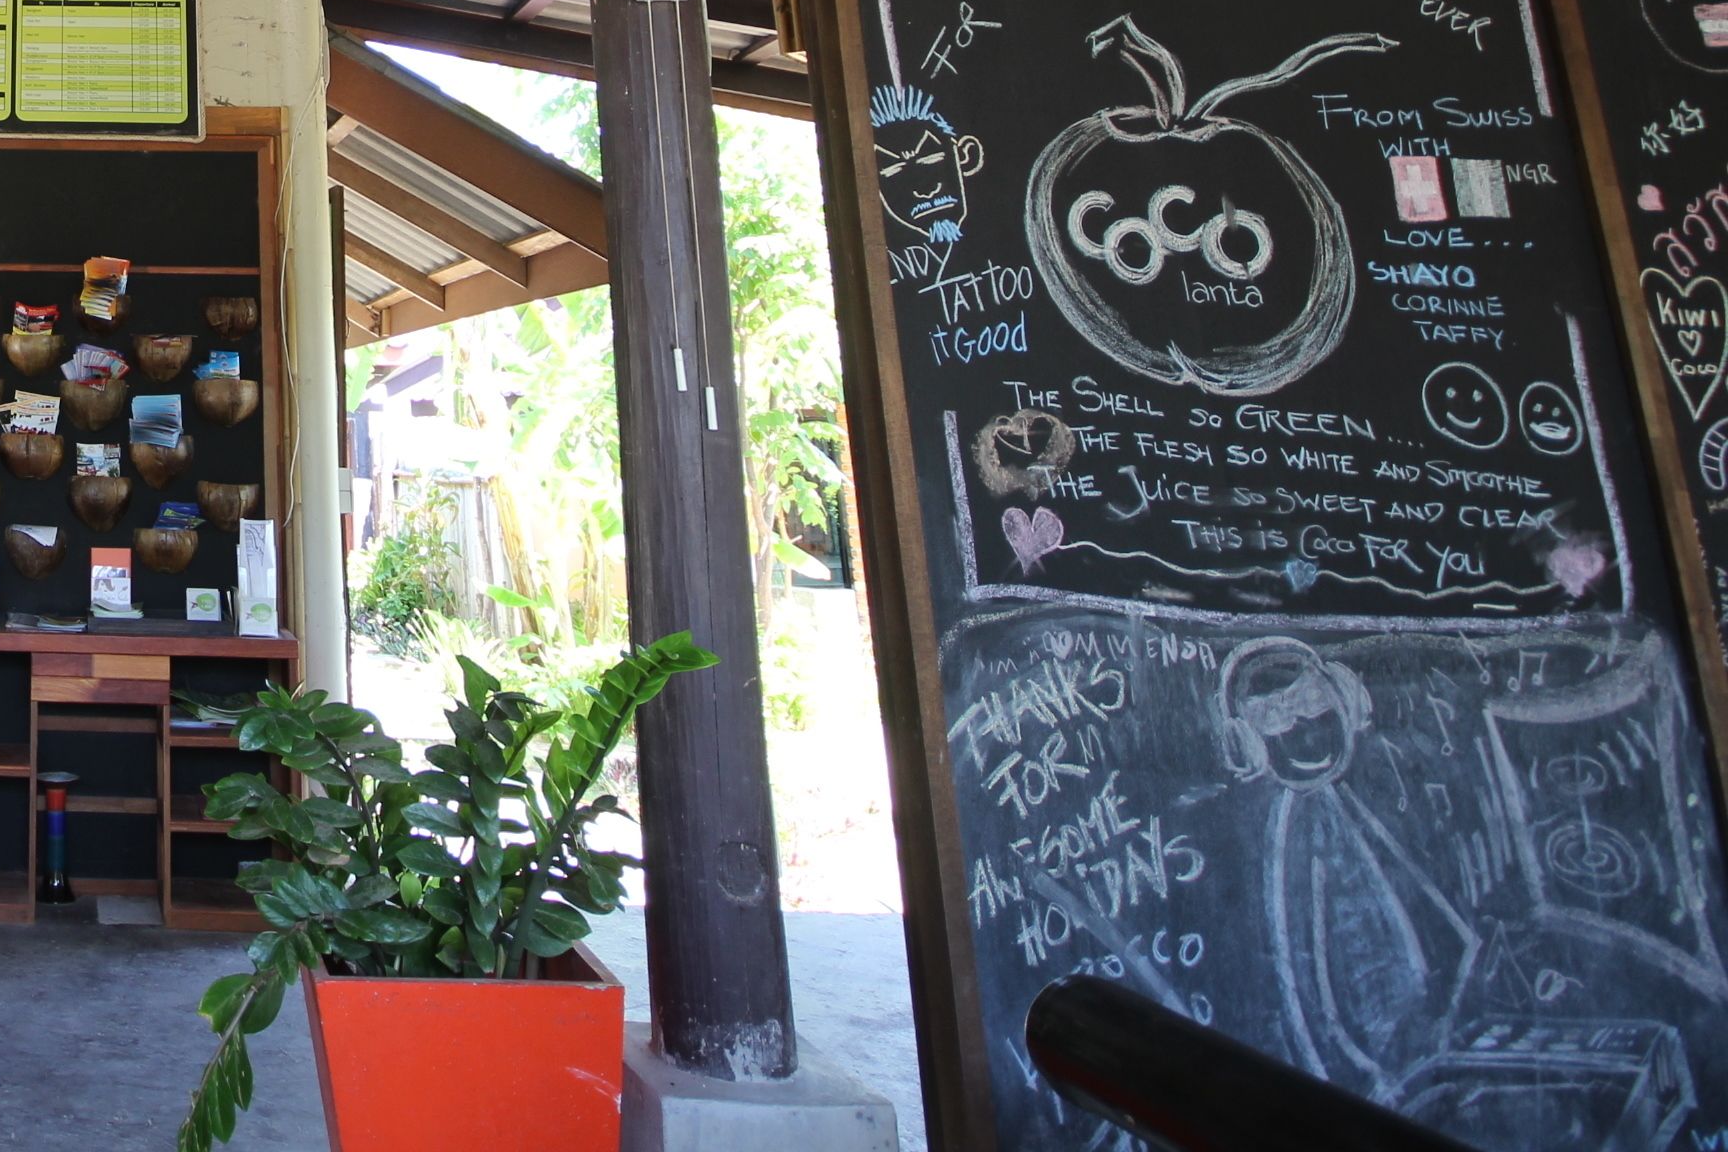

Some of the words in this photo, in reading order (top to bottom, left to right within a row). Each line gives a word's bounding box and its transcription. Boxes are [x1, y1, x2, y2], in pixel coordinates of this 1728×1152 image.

[1311, 94, 1424, 131] FROM
[1432, 97, 1533, 127] SWISS
[1378, 136, 1451, 159] WITH
[1505, 163, 1558, 185] NGR
[885, 242, 953, 285] NDY
[1367, 260, 1476, 287] SHAYO
[918, 259, 1033, 325] TATTOO
[1181, 270, 1264, 308] lanta
[1391, 293, 1505, 316] CORINNE
[1413, 319, 1505, 351] TAFFY
[1002, 381, 1062, 410] THE
[1071, 375, 1164, 416] SHELL
[1068, 425, 1120, 453] THE
[1133, 432, 1214, 467] FLESH
[1226, 446, 1269, 465] SO
[1280, 446, 1359, 475] WHITE
[1373, 460, 1421, 482] AND
[1425, 460, 1552, 498] SMOOTHE
[1027, 463, 1103, 500] THE
[1275, 487, 1377, 523] SWEET
[1384, 501, 1444, 523] AND
[1458, 505, 1567, 540] CLEAR
[1358, 532, 1424, 574] FOR
[1425, 541, 1486, 589] YOU
[946, 657, 1125, 776] THANKS
